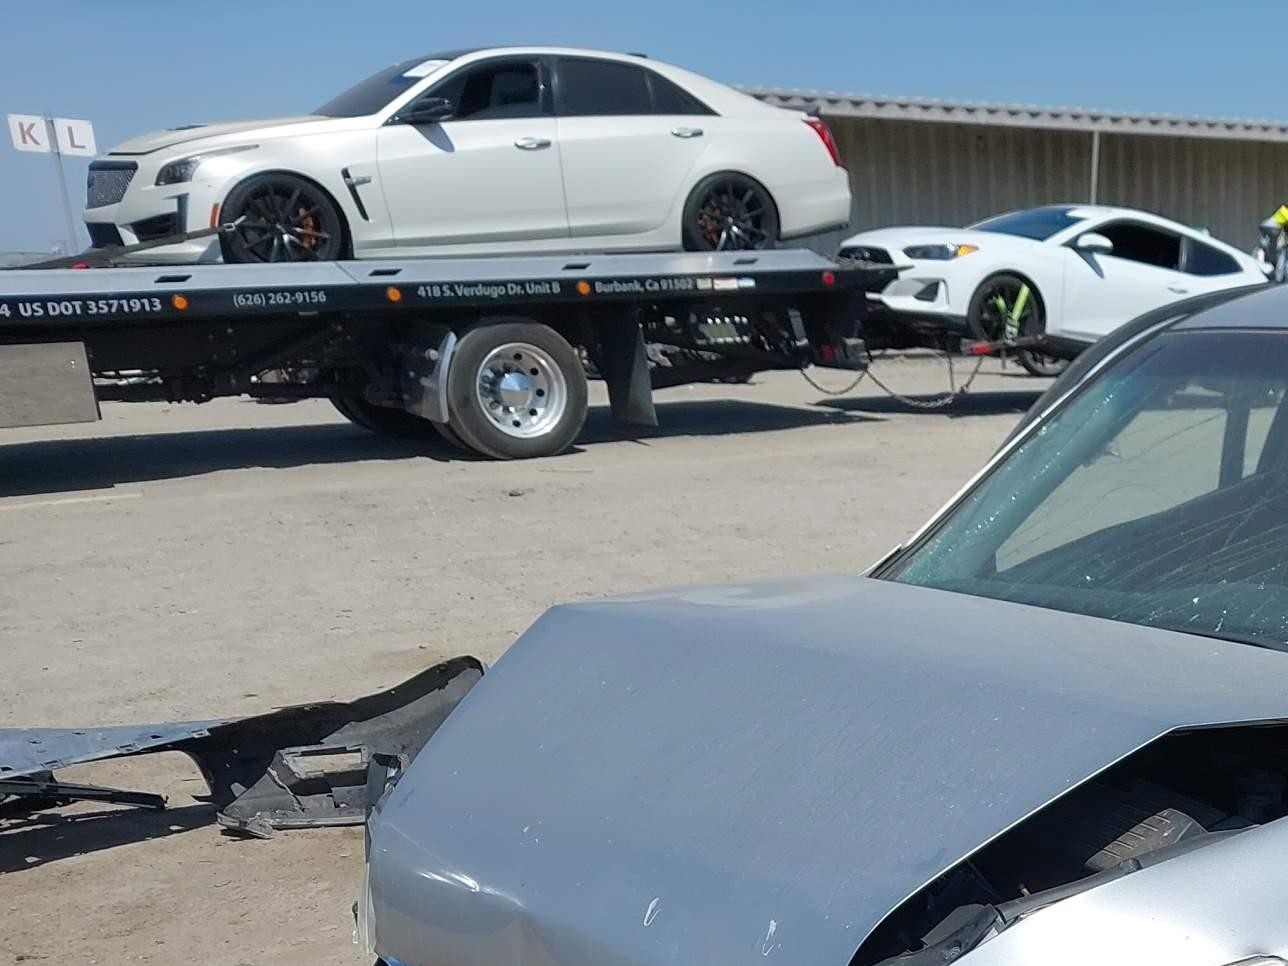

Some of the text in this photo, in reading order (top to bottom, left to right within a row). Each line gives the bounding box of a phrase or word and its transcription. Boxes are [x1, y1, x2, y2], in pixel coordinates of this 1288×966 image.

[18, 121, 41, 146] K
[67, 125, 86, 149] L
[417, 281, 560, 298] 418 S. Verdugo Dr. Unit B
[595, 280, 644, 293] Burbank,
[645, 279, 660, 291] Ca
[18, 302, 44, 316] US
[47, 300, 82, 315] DOT
[87, 297, 162, 314] 3571913
[233, 291, 327, 308] (626) 262-9156
